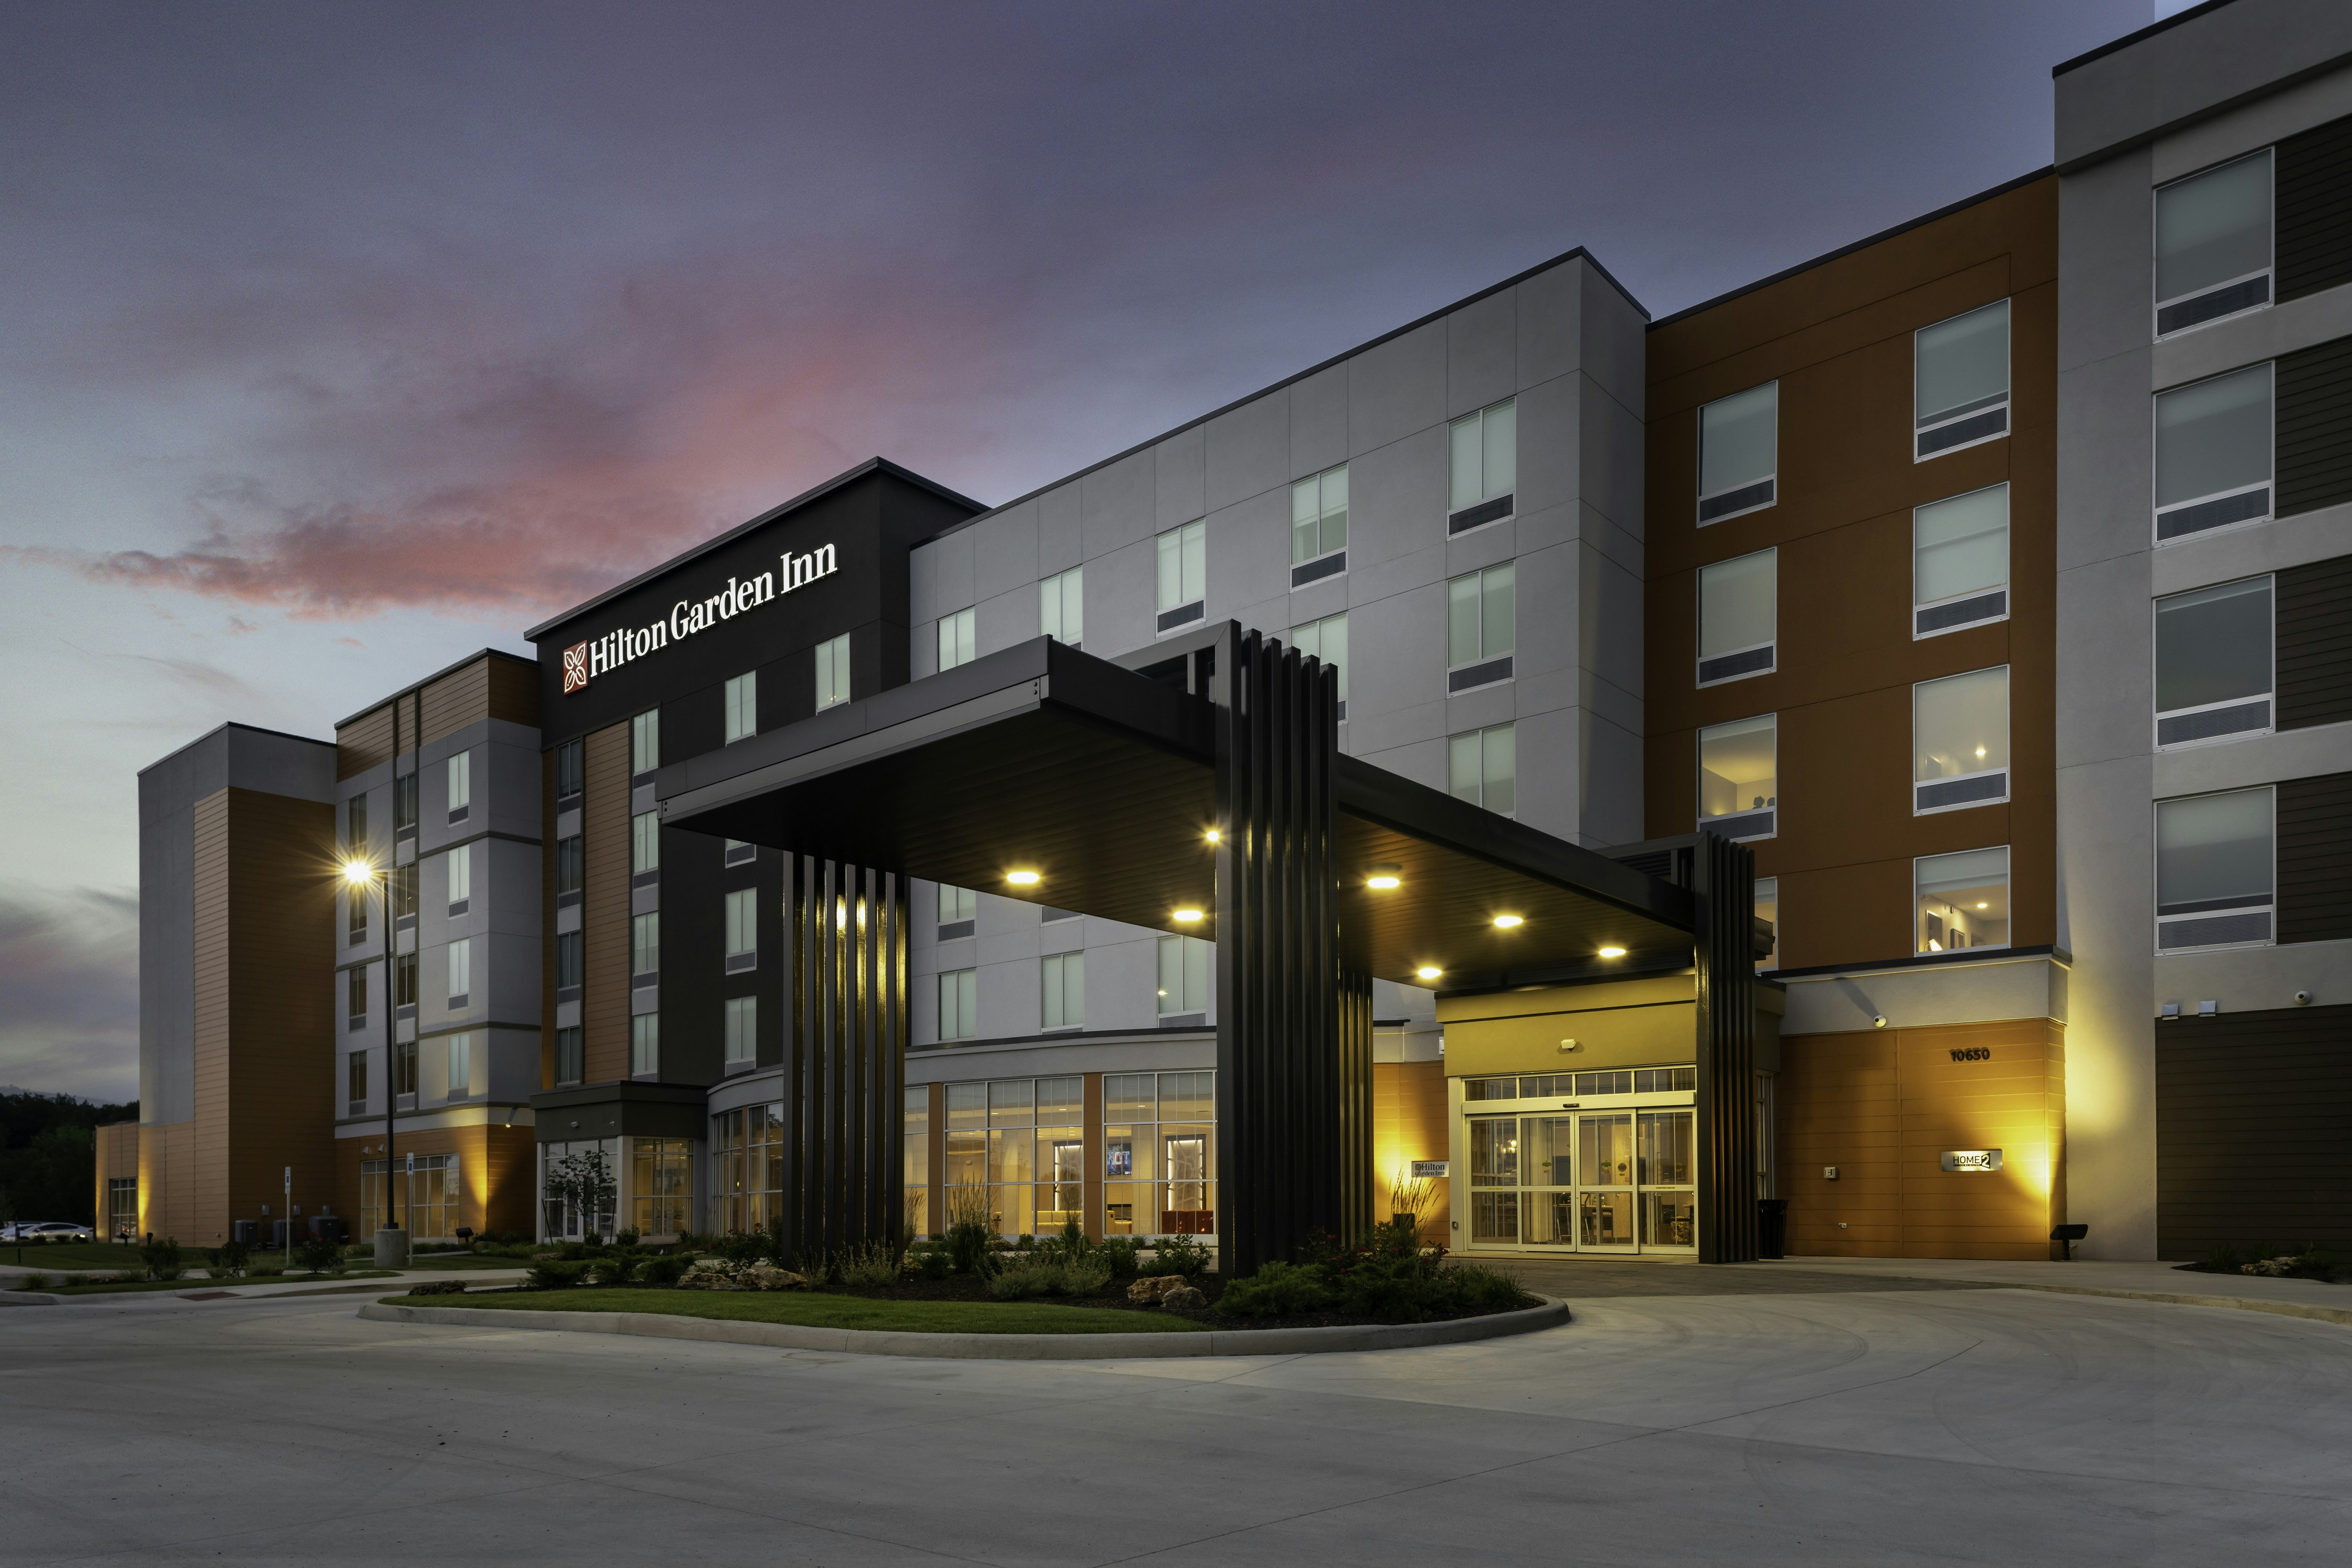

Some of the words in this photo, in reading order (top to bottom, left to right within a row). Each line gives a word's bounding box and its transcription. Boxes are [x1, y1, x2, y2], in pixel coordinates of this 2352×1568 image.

[590, 620, 667, 677] Hilton
[671, 572, 775, 640] Garden
[781, 543, 837, 594] Inn
[1950, 1047, 1990, 1062] 10650
